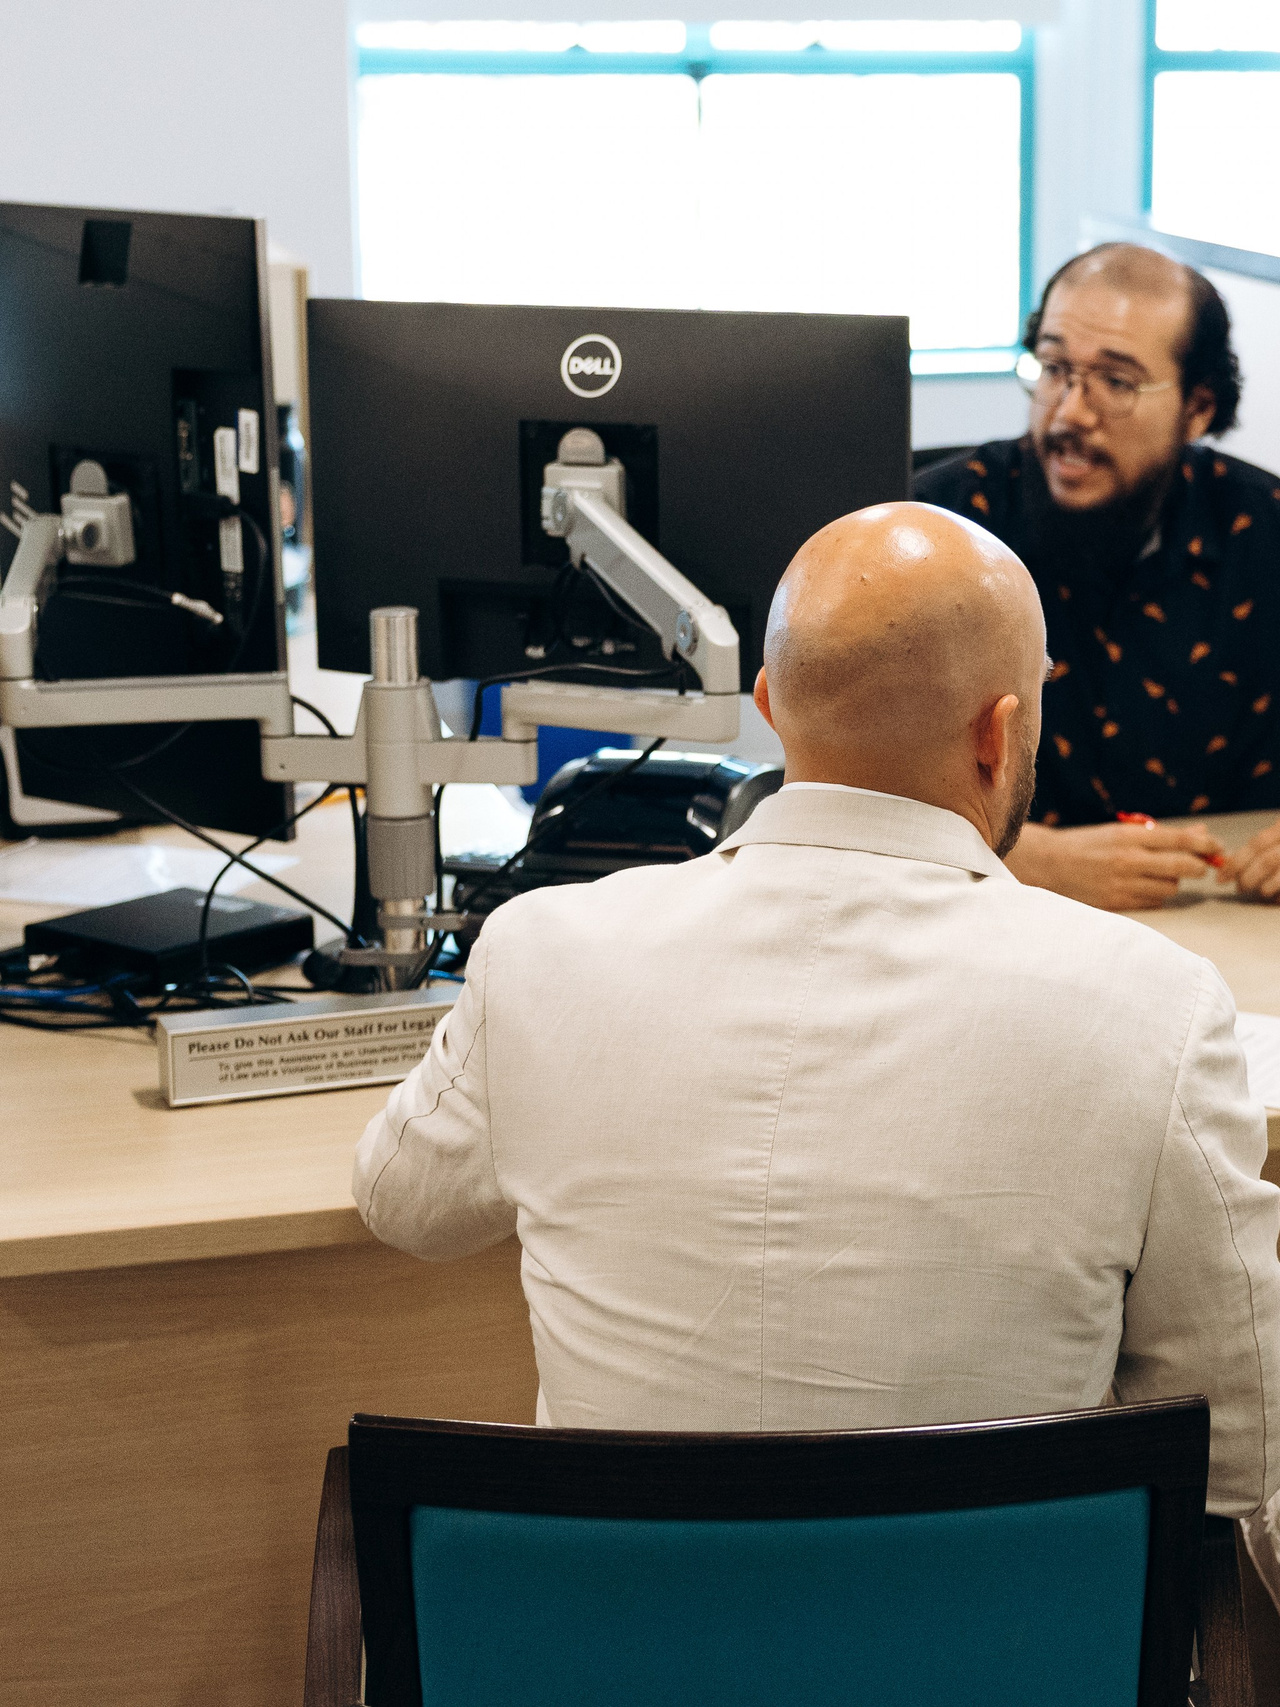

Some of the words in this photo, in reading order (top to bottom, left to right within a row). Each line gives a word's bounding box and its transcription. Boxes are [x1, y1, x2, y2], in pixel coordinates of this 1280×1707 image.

[569, 355, 615, 376] DELL
[188, 1041, 231, 1054] Please
[234, 1037, 254, 1049] Do
[258, 1034, 282, 1046] Not
[287, 1030, 310, 1043] Ask
[314, 1027, 339, 1040] Our
[344, 1023, 373, 1036] Staff
[377, 1022, 398, 1034] For
[402, 1017, 436, 1031] Legal
[218, 1062, 230, 1071] To
[233, 1060, 253, 1071] give
[256, 1058, 274, 1067] this
[279, 1053, 326, 1064] Assistance
[218, 1073, 229, 1083] of
[230, 1072, 249, 1081] Law
[251, 1069, 269, 1079] and
[281, 1064, 323, 1075] Violation
[325, 1062, 335, 1070] of
[336, 1058, 379, 1068] Business
[381, 1054, 400, 1064] and
